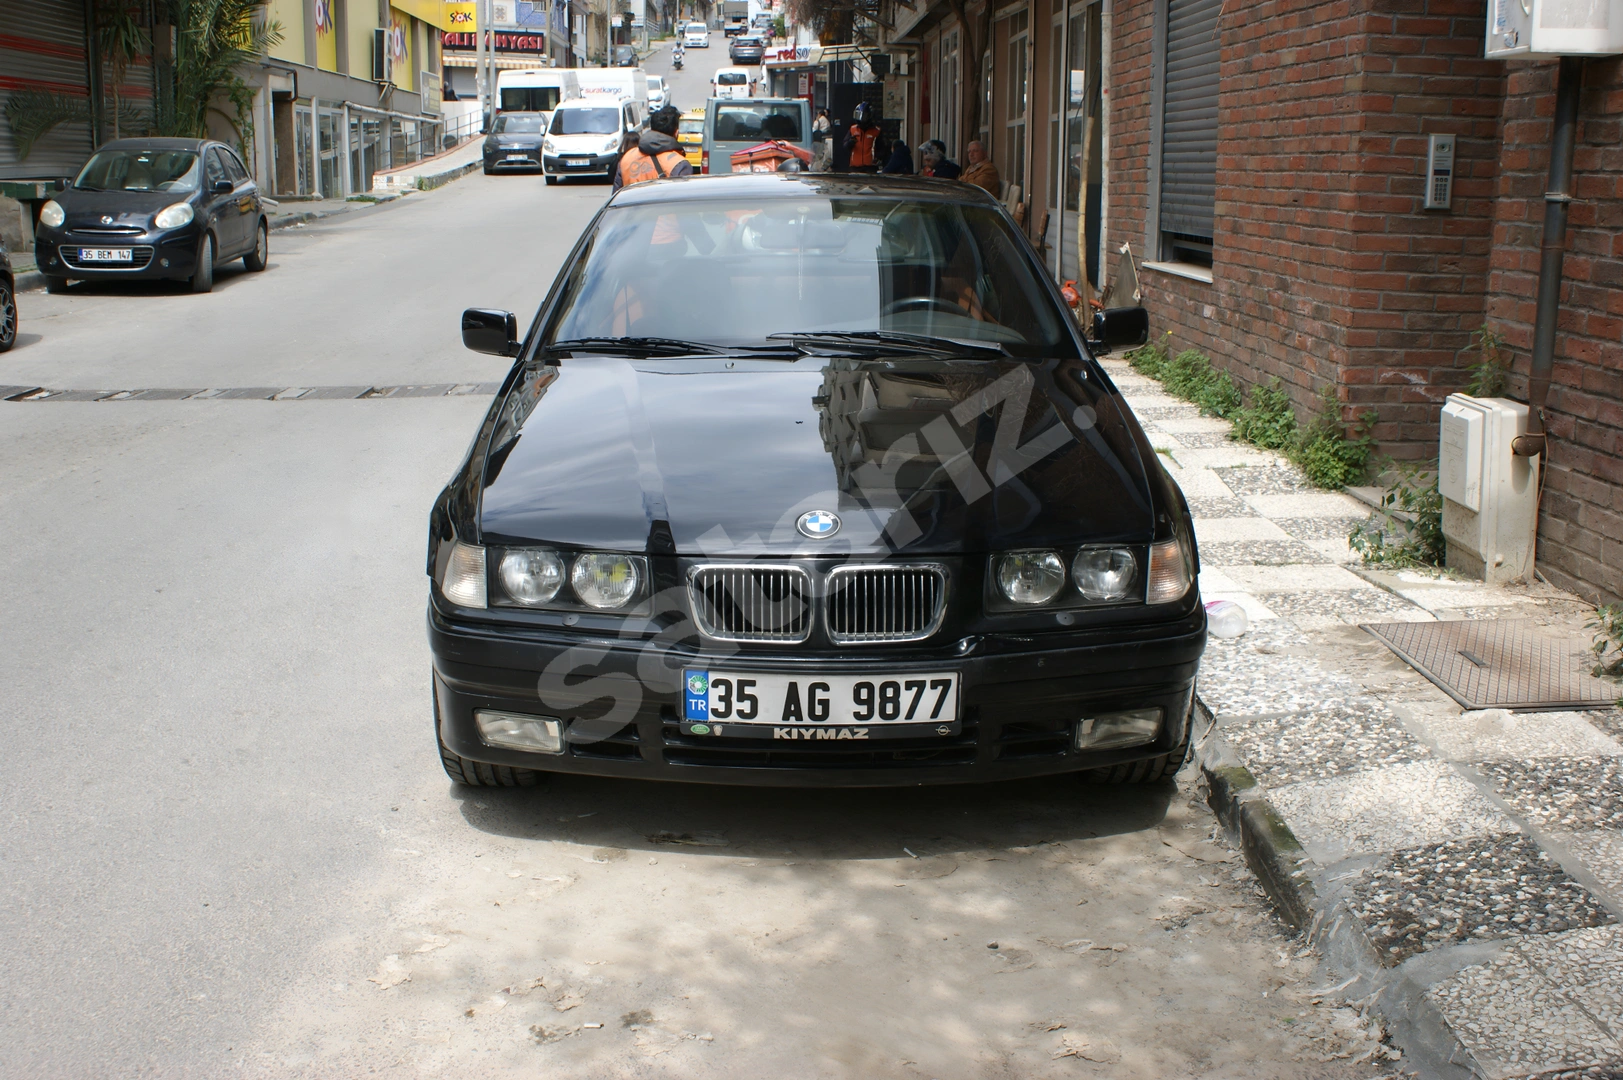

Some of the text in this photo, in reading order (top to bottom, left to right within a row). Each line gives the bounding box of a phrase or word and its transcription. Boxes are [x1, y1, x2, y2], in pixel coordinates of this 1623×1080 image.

[450, 10, 473, 24] ŞOK
[83, 250, 131, 259] 35 BEM 147
[689, 679, 952, 722] TR 35 AG 9877
[773, 727, 869, 740] KIYMAZ
